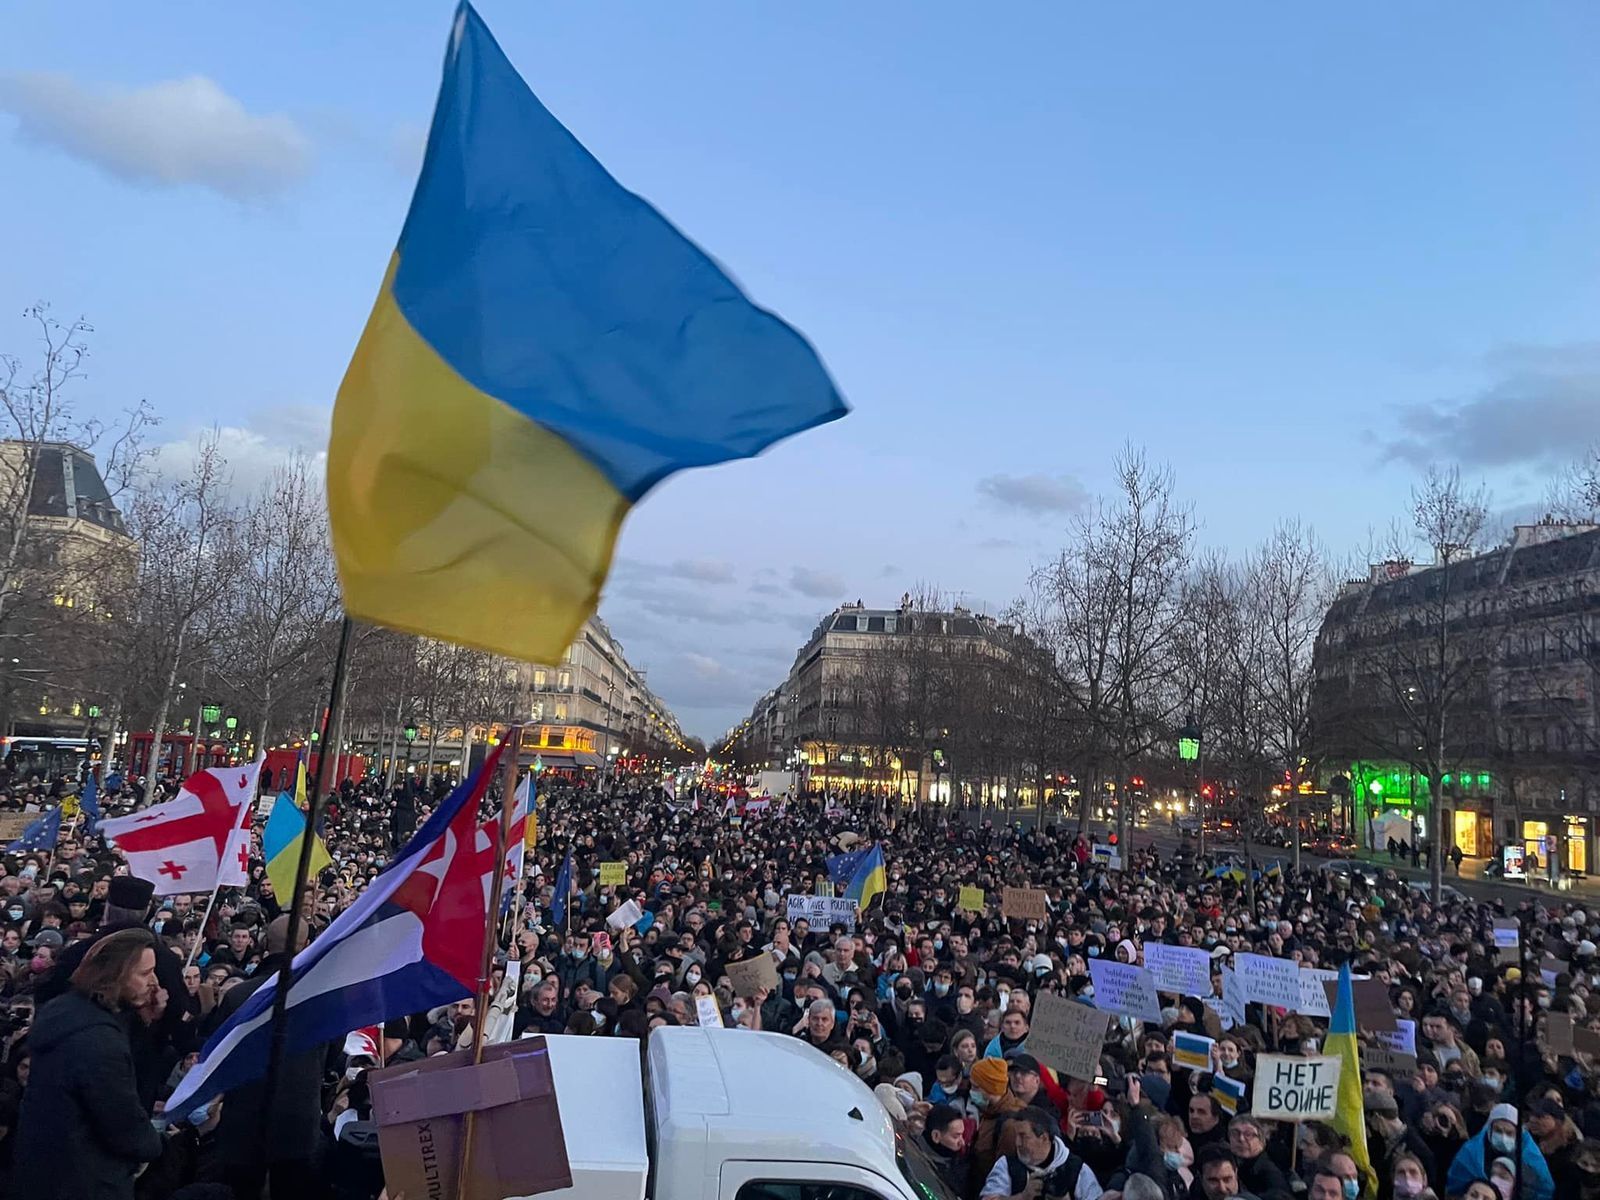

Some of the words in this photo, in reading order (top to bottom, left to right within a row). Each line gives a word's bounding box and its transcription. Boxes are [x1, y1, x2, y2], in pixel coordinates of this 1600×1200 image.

[788, 897, 805, 910] AGIR
[810, 900, 825, 911] AVEC
[830, 899, 857, 912] POUTINE
[1252, 960, 1290, 973] Alliance
[1244, 968, 1260, 976] des
[1262, 971, 1300, 984] Femmes
[1255, 980, 1276, 990] pour
[1280, 982, 1288, 991] la
[1276, 1062, 1324, 1086] НЕТ
